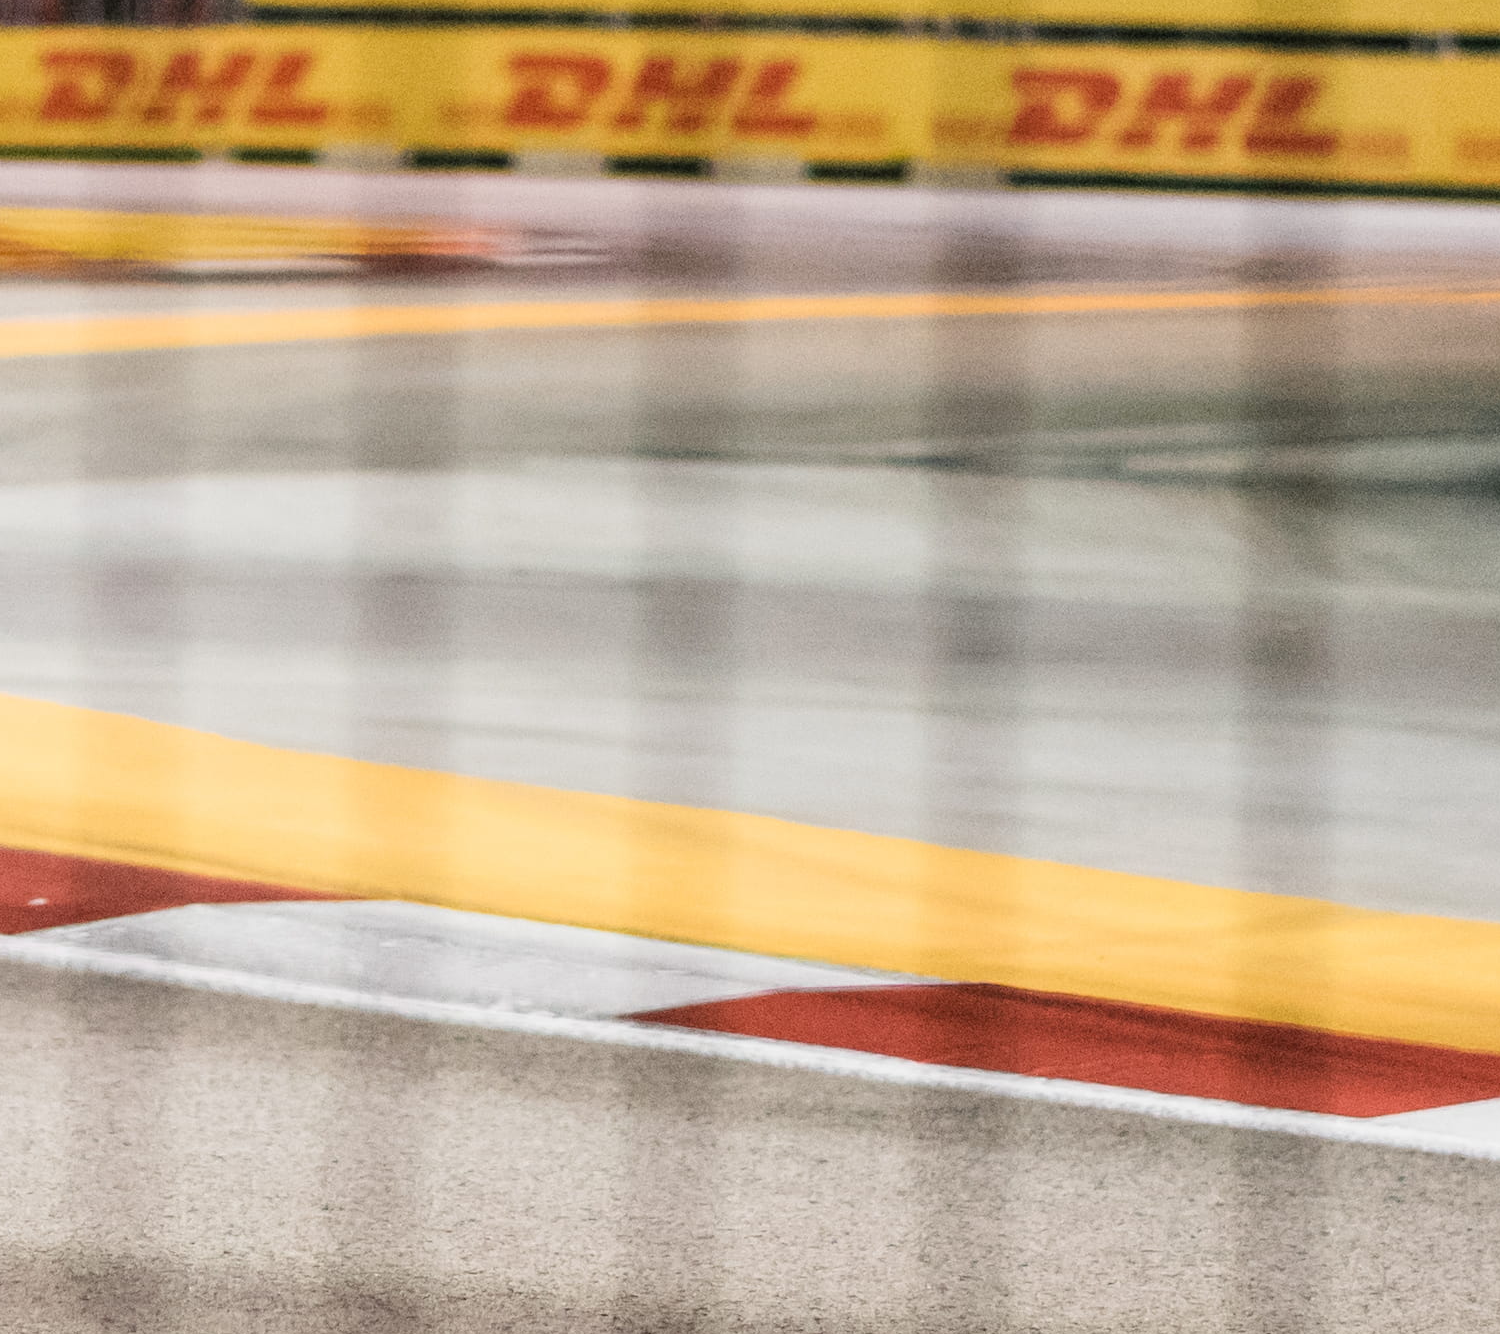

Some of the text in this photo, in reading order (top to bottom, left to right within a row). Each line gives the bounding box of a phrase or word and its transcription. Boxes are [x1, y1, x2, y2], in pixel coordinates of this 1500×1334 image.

[38, 48, 327, 124] DHL
[503, 53, 815, 138] DHL
[1006, 70, 1340, 154] DHL
